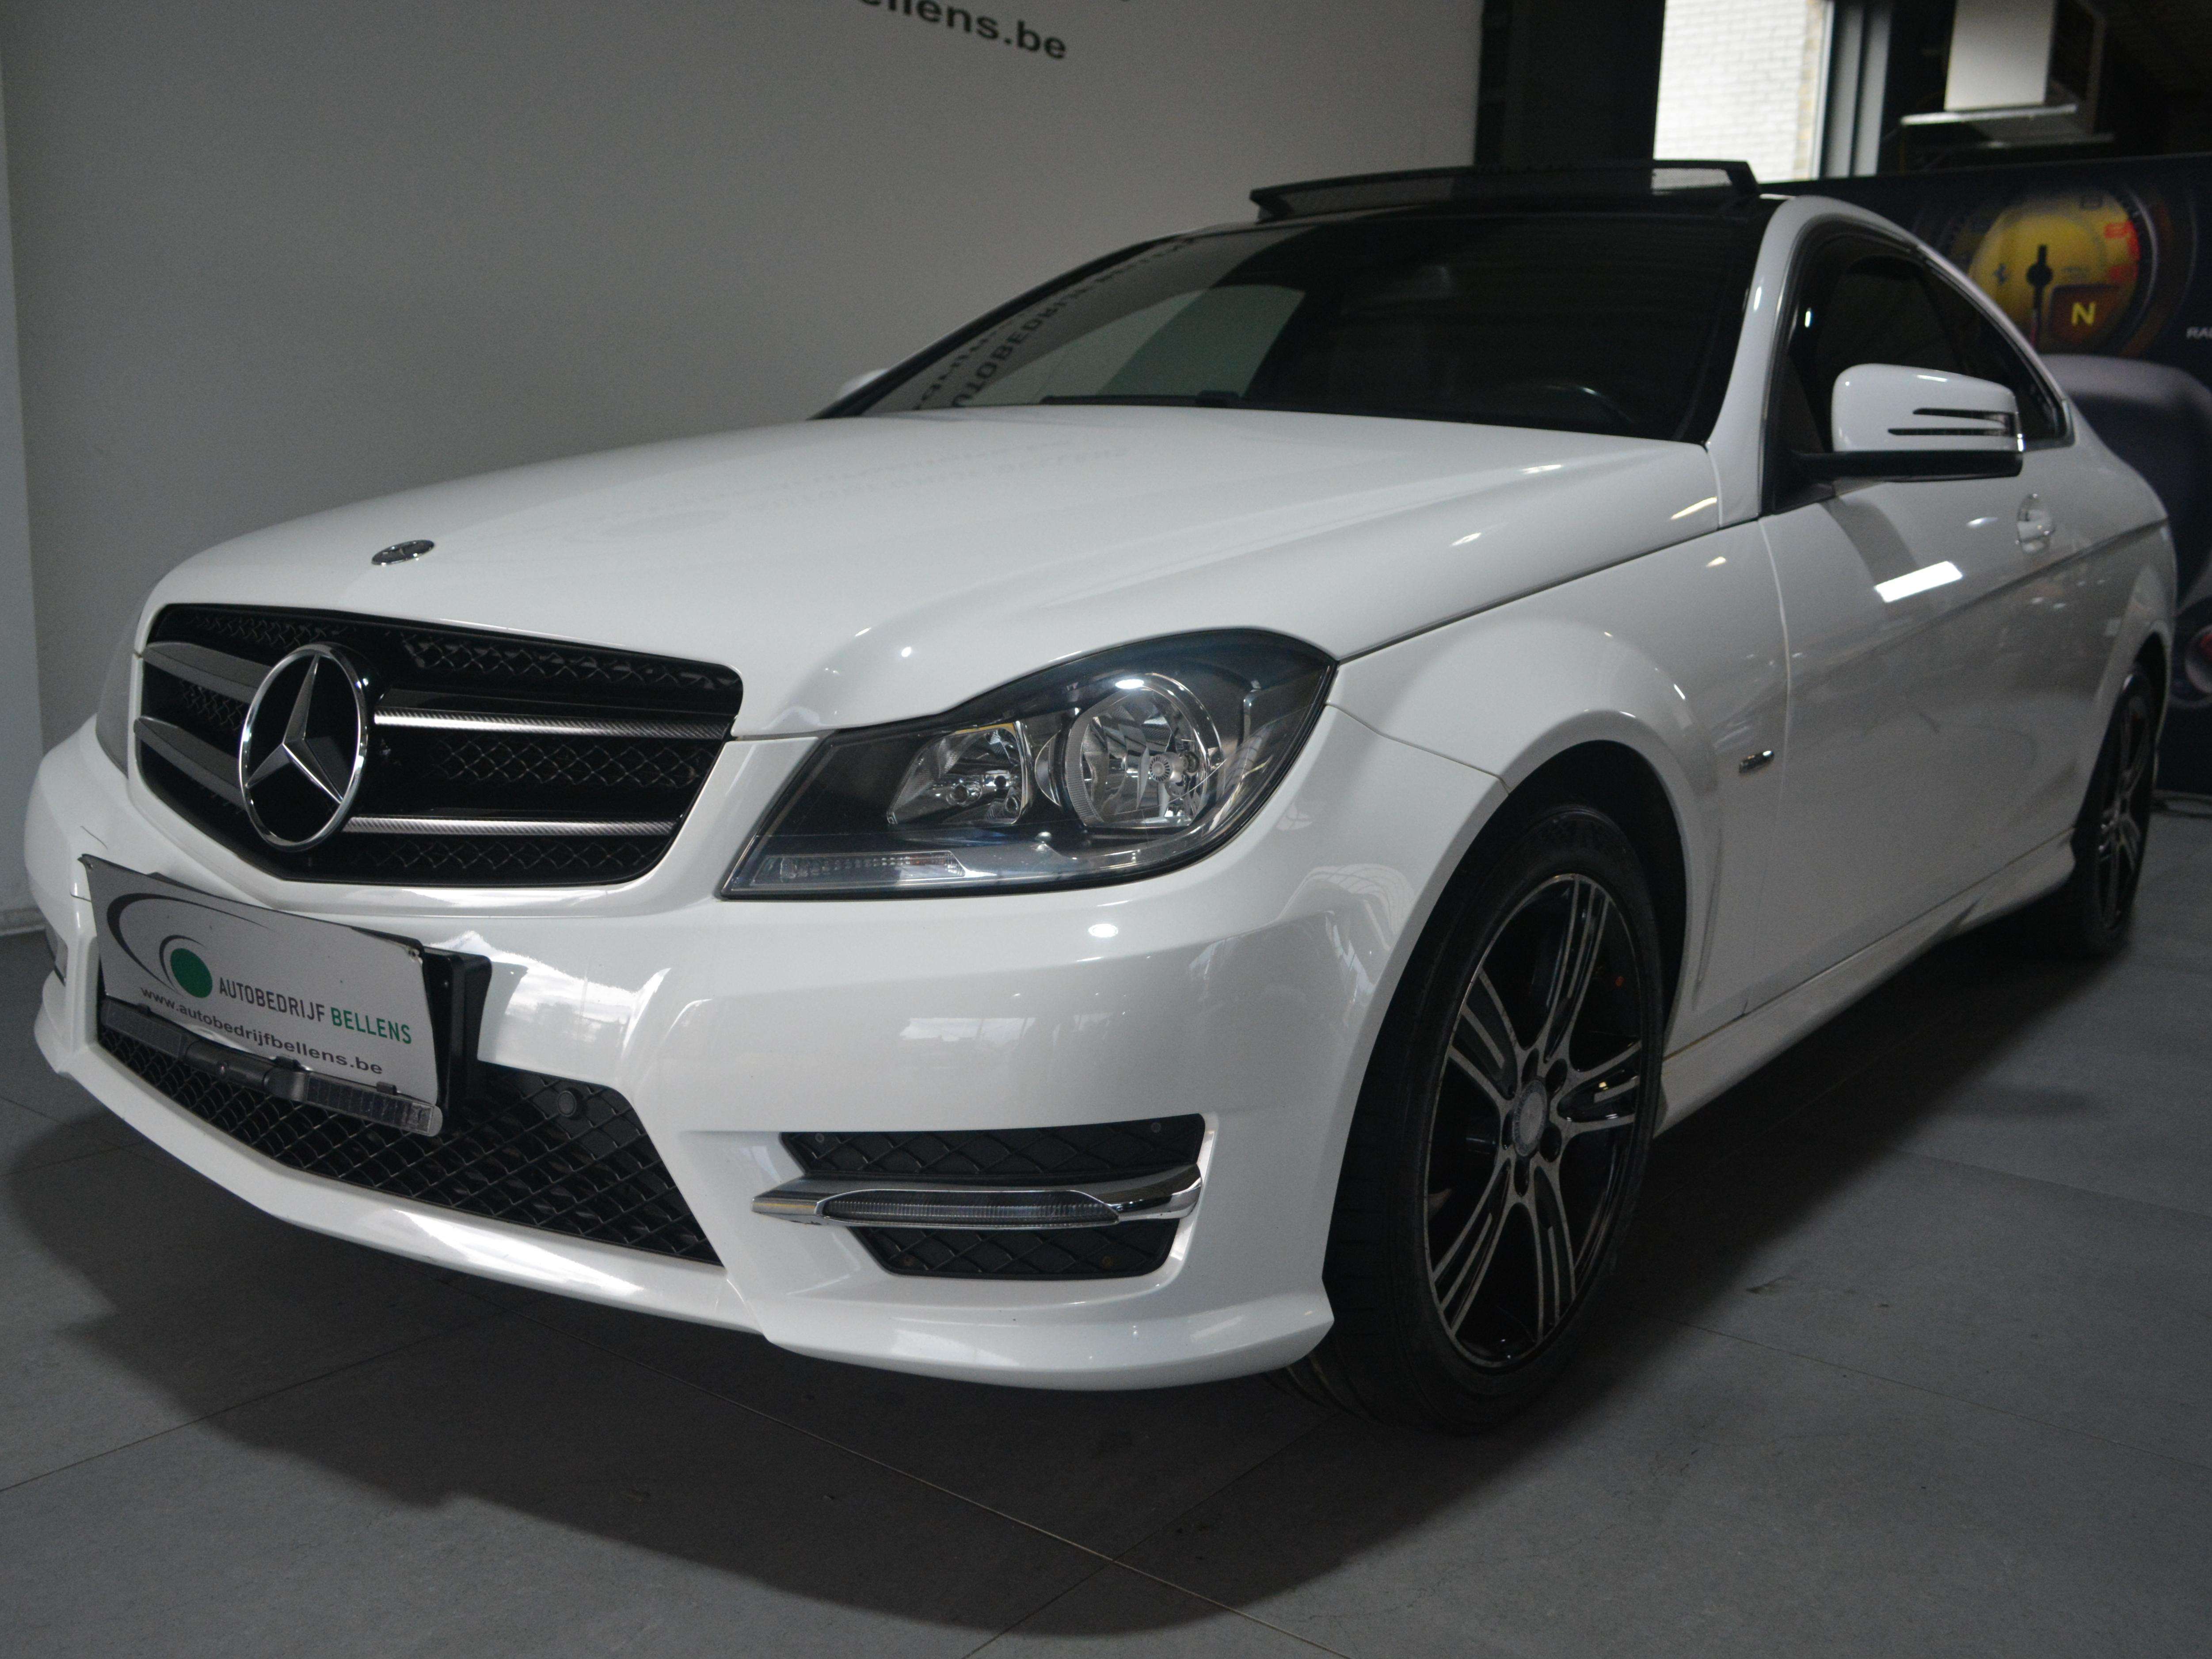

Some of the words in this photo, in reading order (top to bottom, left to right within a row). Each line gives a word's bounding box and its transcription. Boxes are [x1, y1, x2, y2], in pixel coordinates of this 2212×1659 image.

[2071, 302, 2096, 326] N
[140, 987, 383, 1074] www.autobedrijfbellens.be
[219, 977, 325, 1022] AUTOBEDRIJF
[331, 1006, 412, 1045] BELLENS
